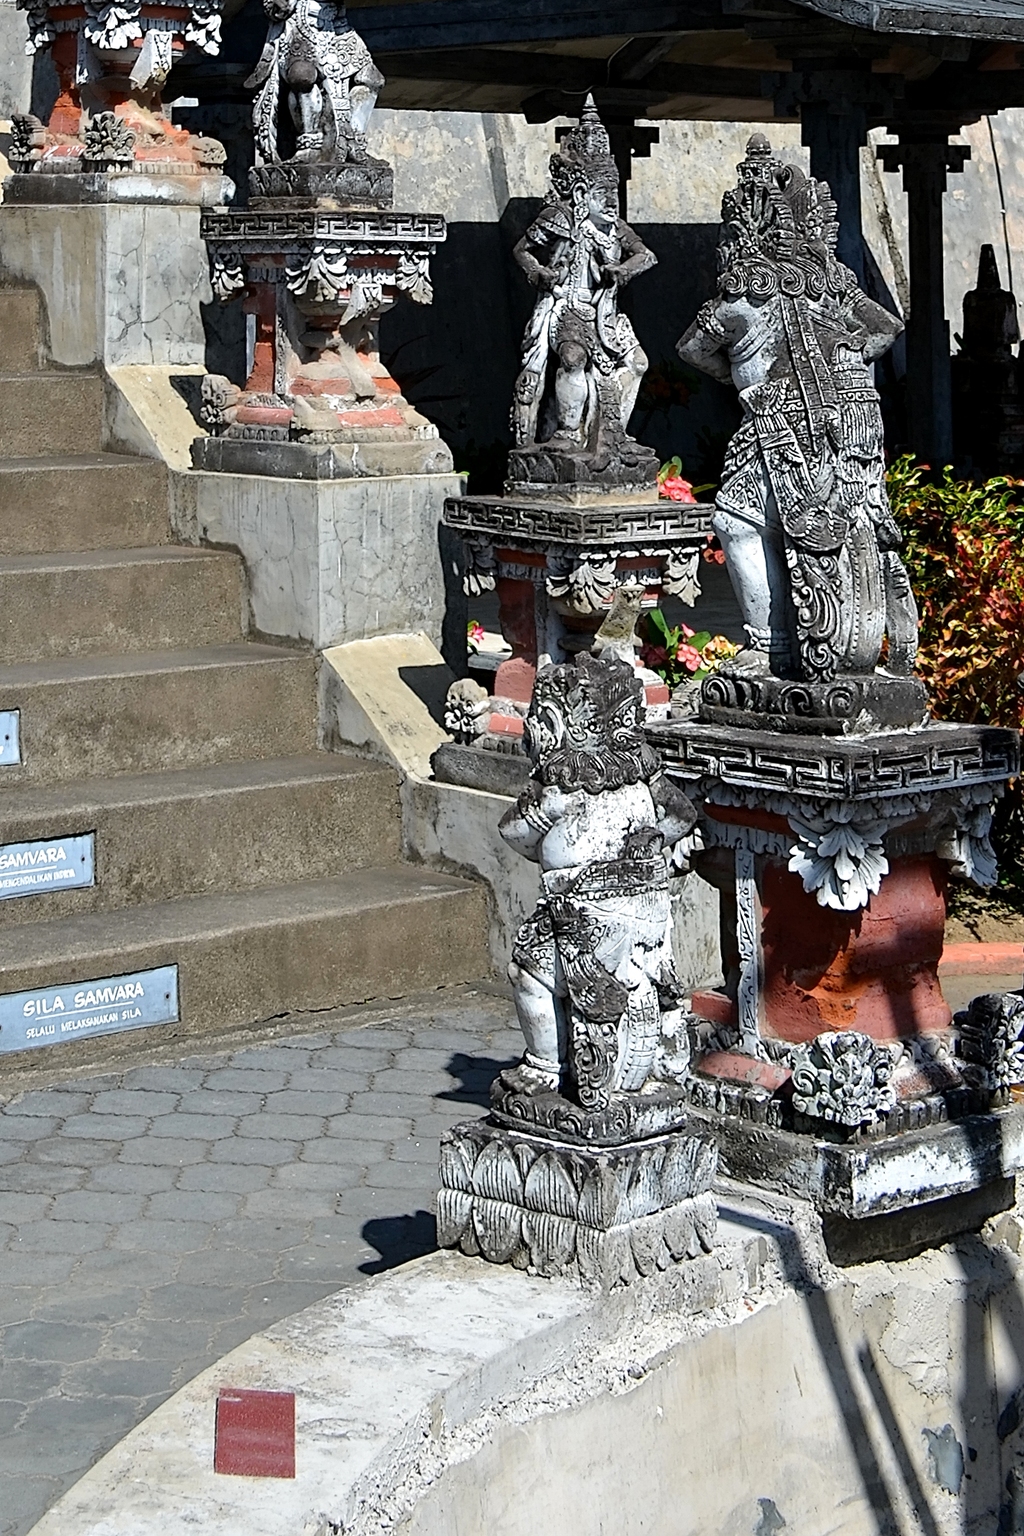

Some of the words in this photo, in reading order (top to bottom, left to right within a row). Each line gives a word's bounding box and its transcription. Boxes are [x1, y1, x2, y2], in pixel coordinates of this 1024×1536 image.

[23, 995, 65, 1017] SILA
[74, 981, 144, 1008] SAMVARA
[26, 1025, 55, 1039] SELALU
[61, 1012, 119, 1032] MELAKSANAKAN
[122, 1007, 141, 1020] SILA
